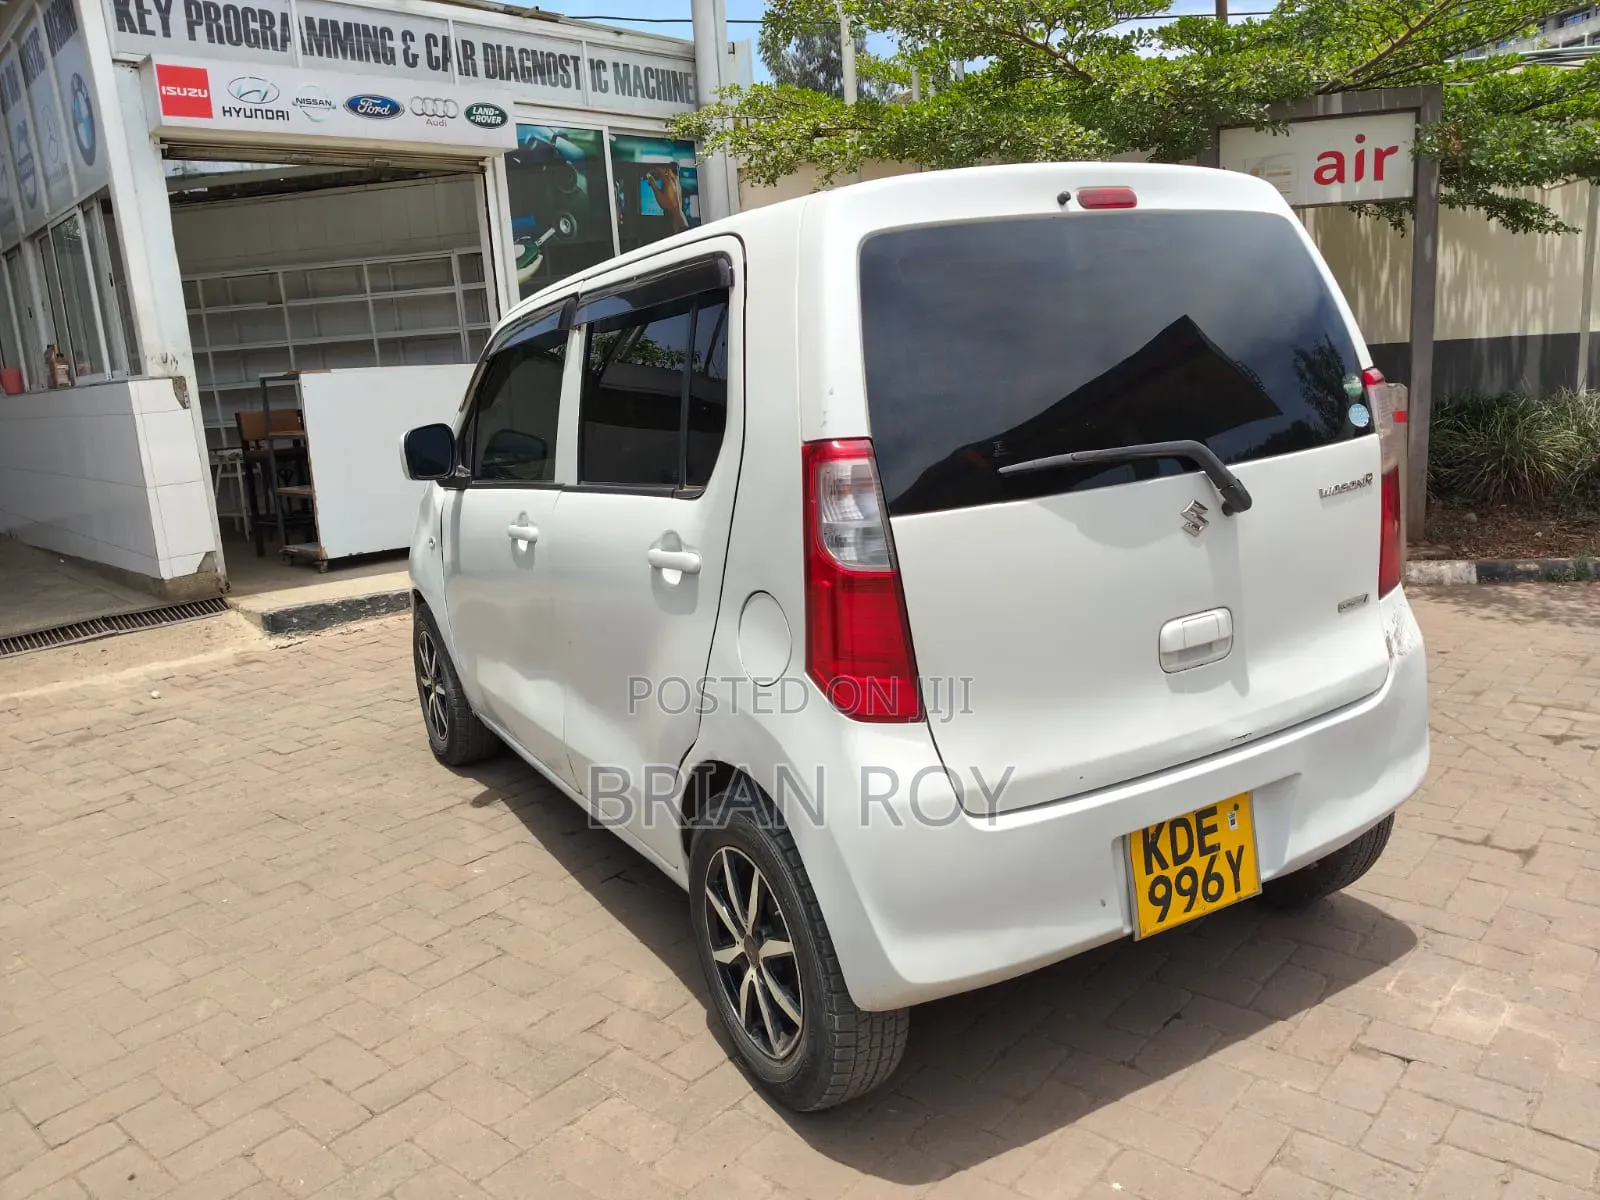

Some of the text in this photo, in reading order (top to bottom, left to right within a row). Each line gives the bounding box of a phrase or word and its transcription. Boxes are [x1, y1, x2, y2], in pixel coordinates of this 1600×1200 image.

[113, 0, 173, 38] KEY
[403, 27, 419, 68] &
[425, 33, 477, 77] CAR
[161, 85, 208, 98] ISUZU
[295, 97, 332, 107] NISSAN
[357, 97, 391, 115] Ford
[222, 106, 290, 121] HYUNDAI
[474, 115, 502, 125] ROVER
[425, 118, 448, 128] Audi
[1313, 134, 1399, 185] air
[1142, 806, 1221, 876] KDE
[1148, 845, 1244, 923] 996Y
